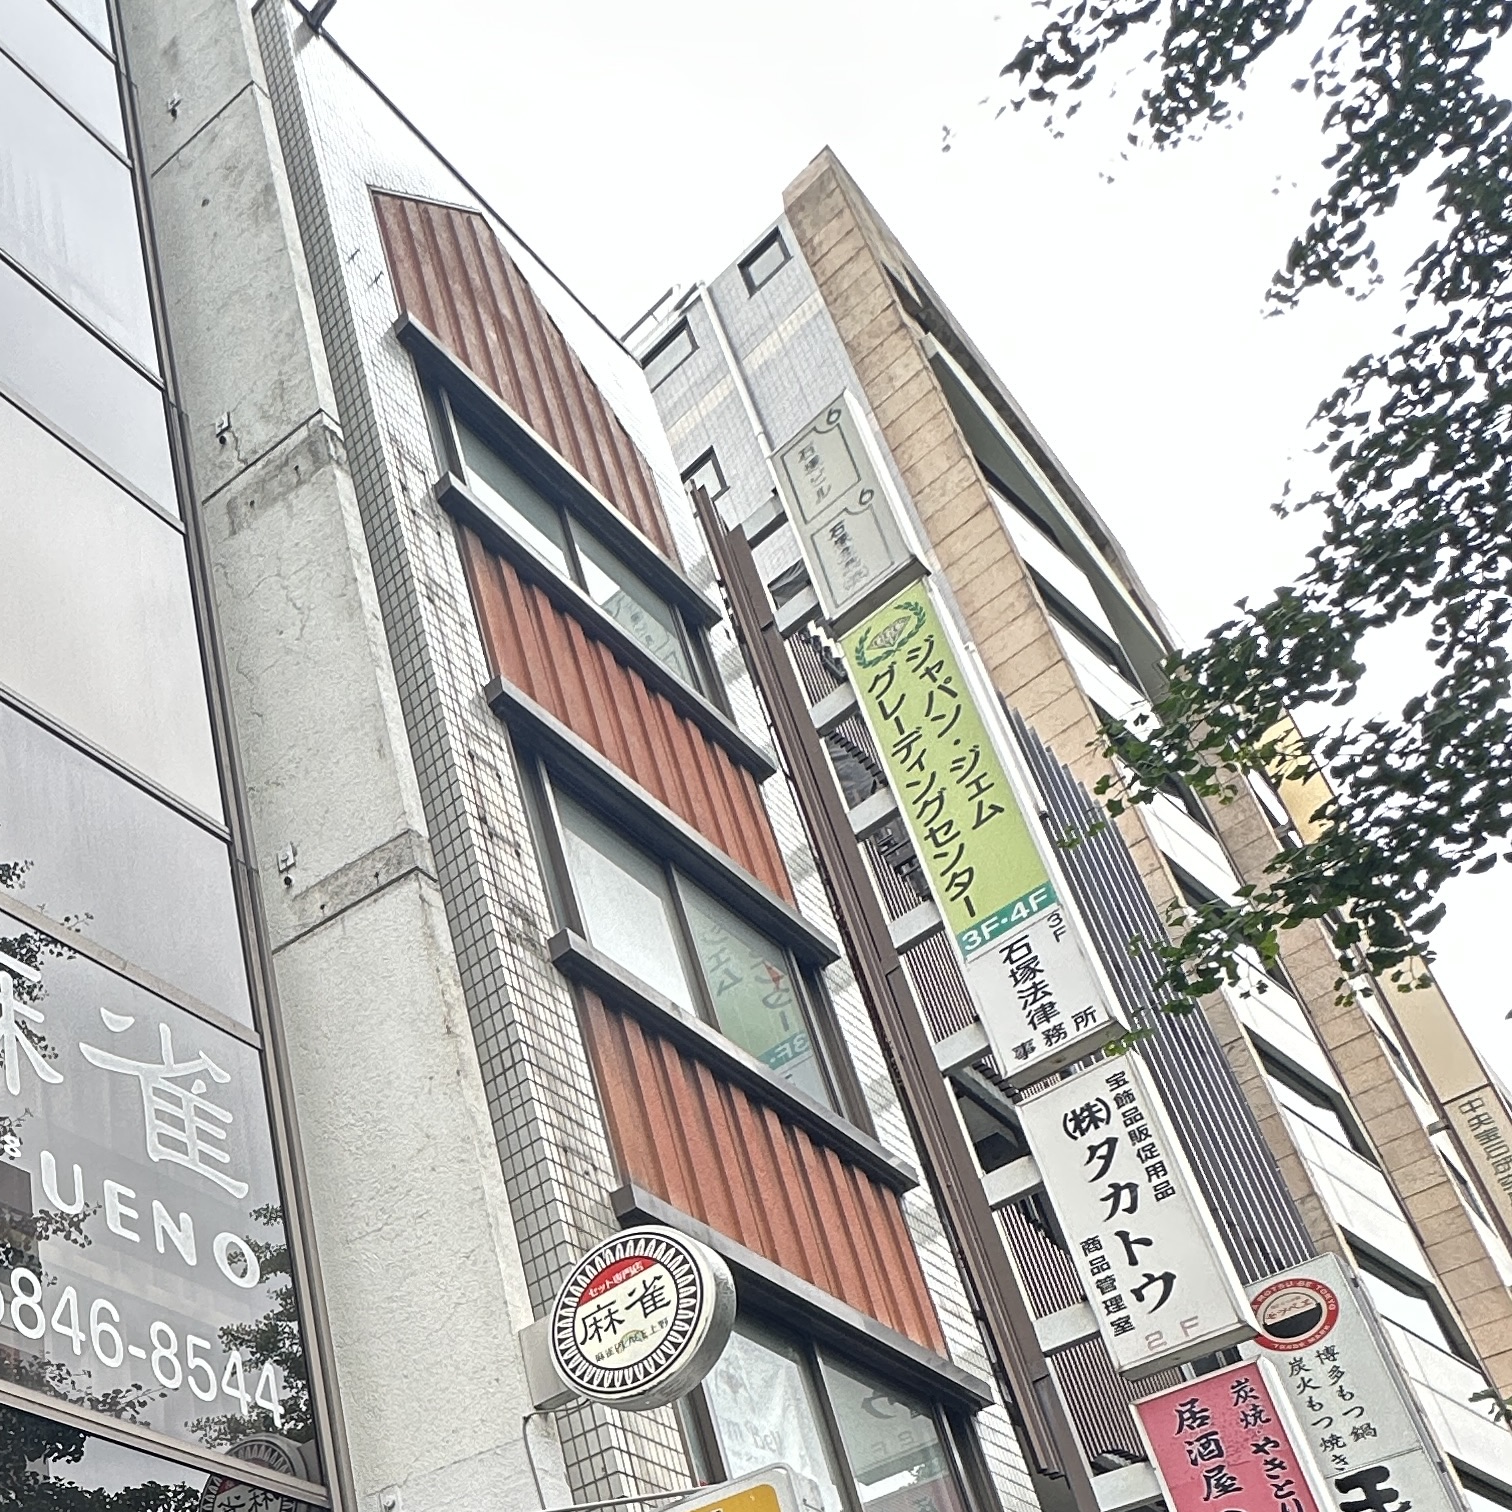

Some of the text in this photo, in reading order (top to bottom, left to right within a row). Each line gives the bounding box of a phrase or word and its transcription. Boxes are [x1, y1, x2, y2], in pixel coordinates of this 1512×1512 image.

[868, 661, 978, 920] グレーディングセンター
[1047, 913, 1068, 943] 3F
[1105, 1070, 1176, 1203] 宝飾品販促用品
[39, 1149, 264, 1290] UENO
[579, 1274, 672, 1346] 麻雀
[588, 1261, 644, 1297] セット専門店
[1080, 1235, 1136, 1337] 商品管理室
[1288, 1357, 1348, 1471] 炭火もつ焼き
[1314, 1344, 1379, 1443] 博多もつ鍋
[1174, 1398, 1244, 1502] 居酒屋
